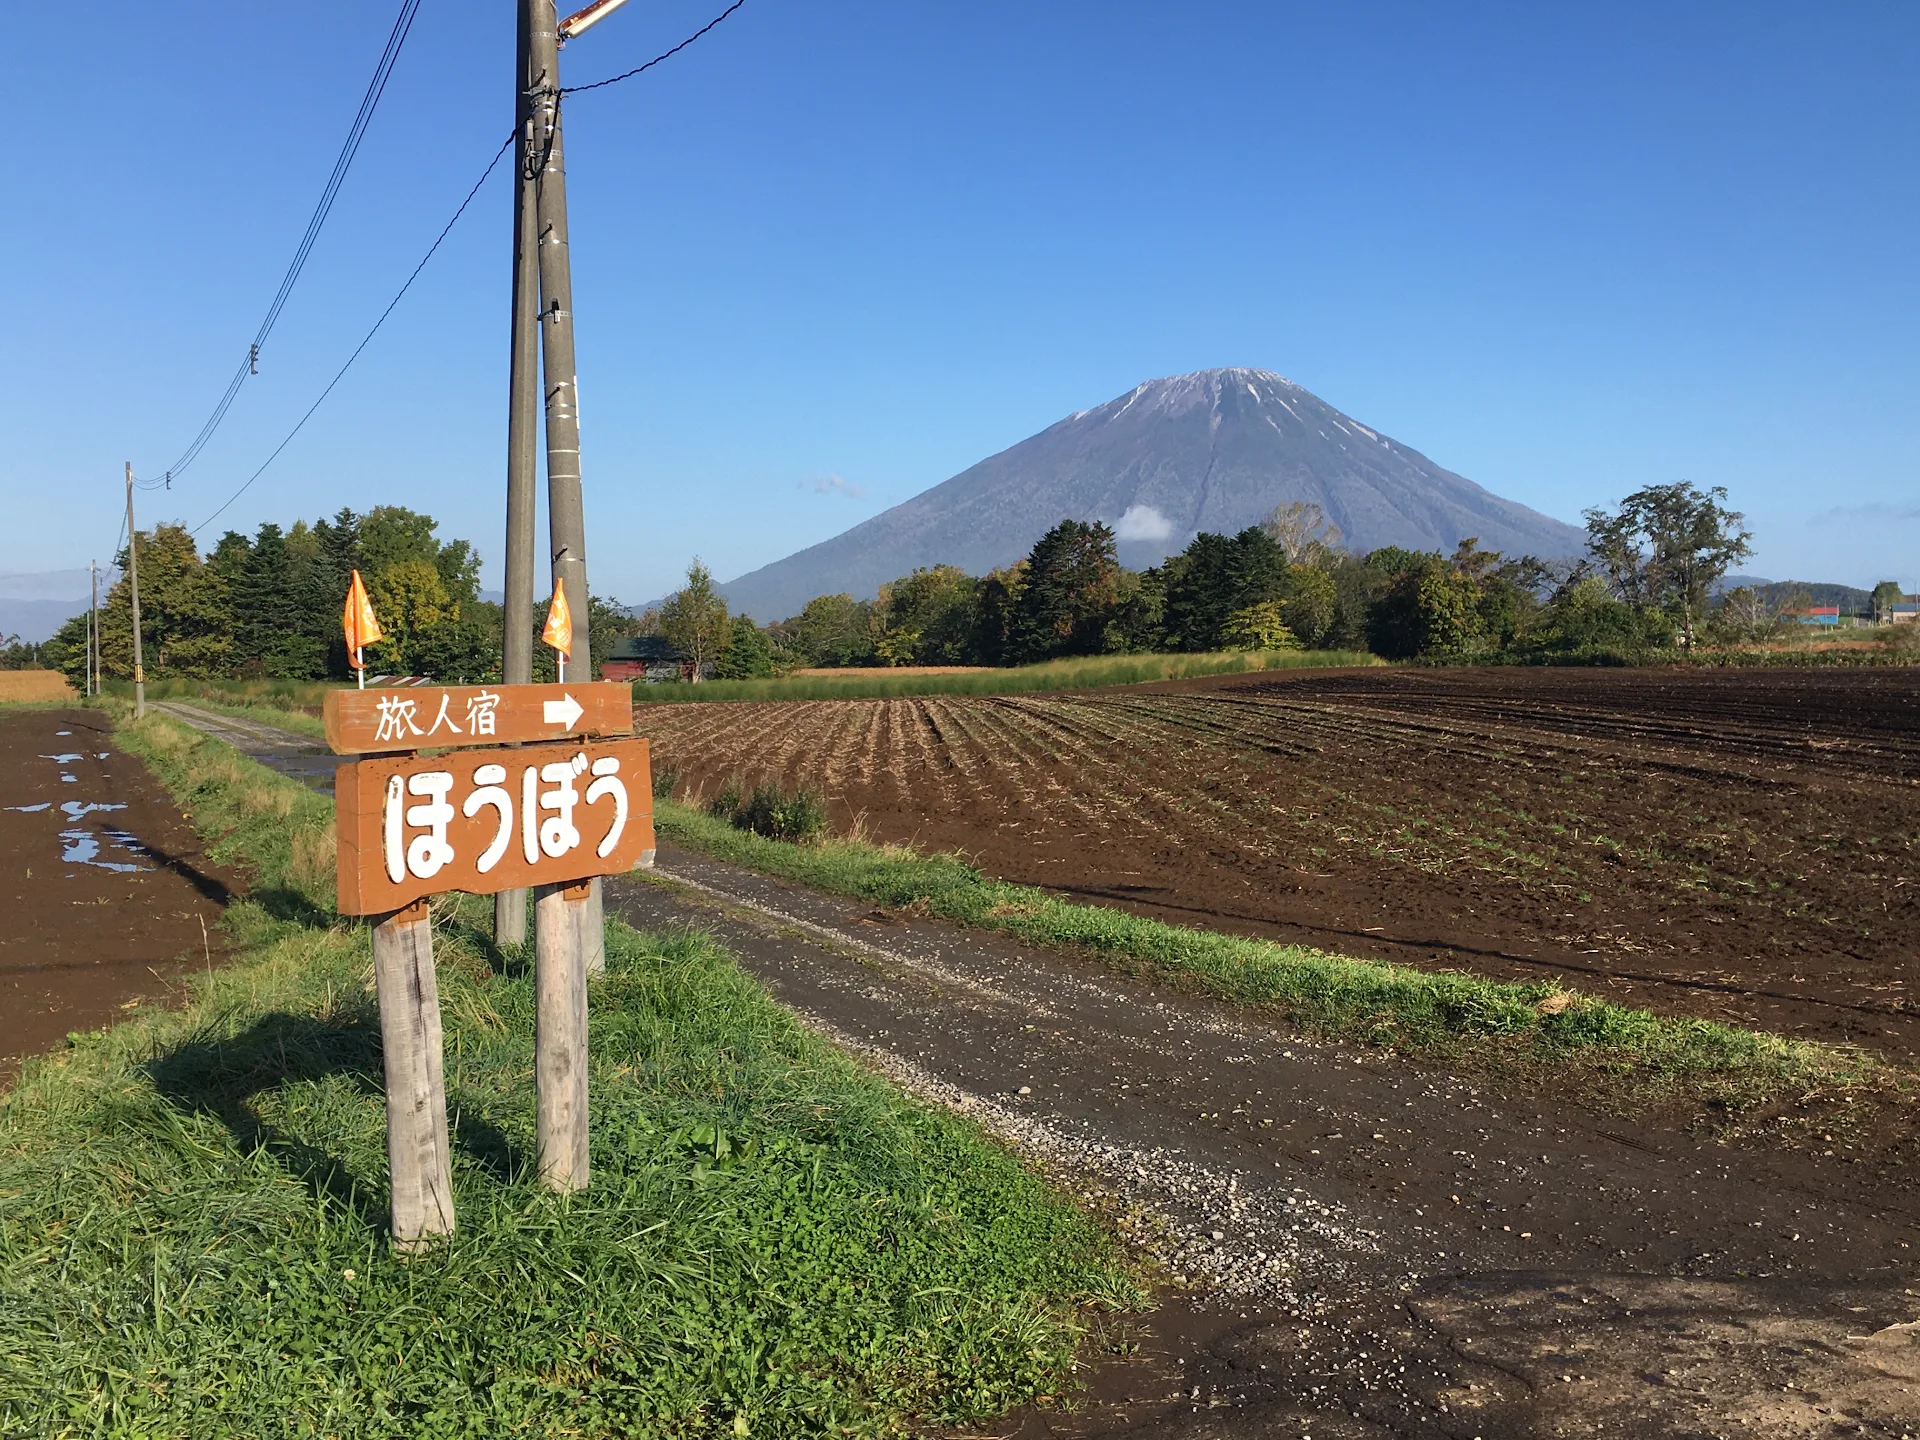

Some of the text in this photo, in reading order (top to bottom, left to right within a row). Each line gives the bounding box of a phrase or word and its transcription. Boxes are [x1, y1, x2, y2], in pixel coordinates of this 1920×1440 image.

[375, 691, 500, 741] 旅人宿
[384, 752, 628, 884] ほうぼう
